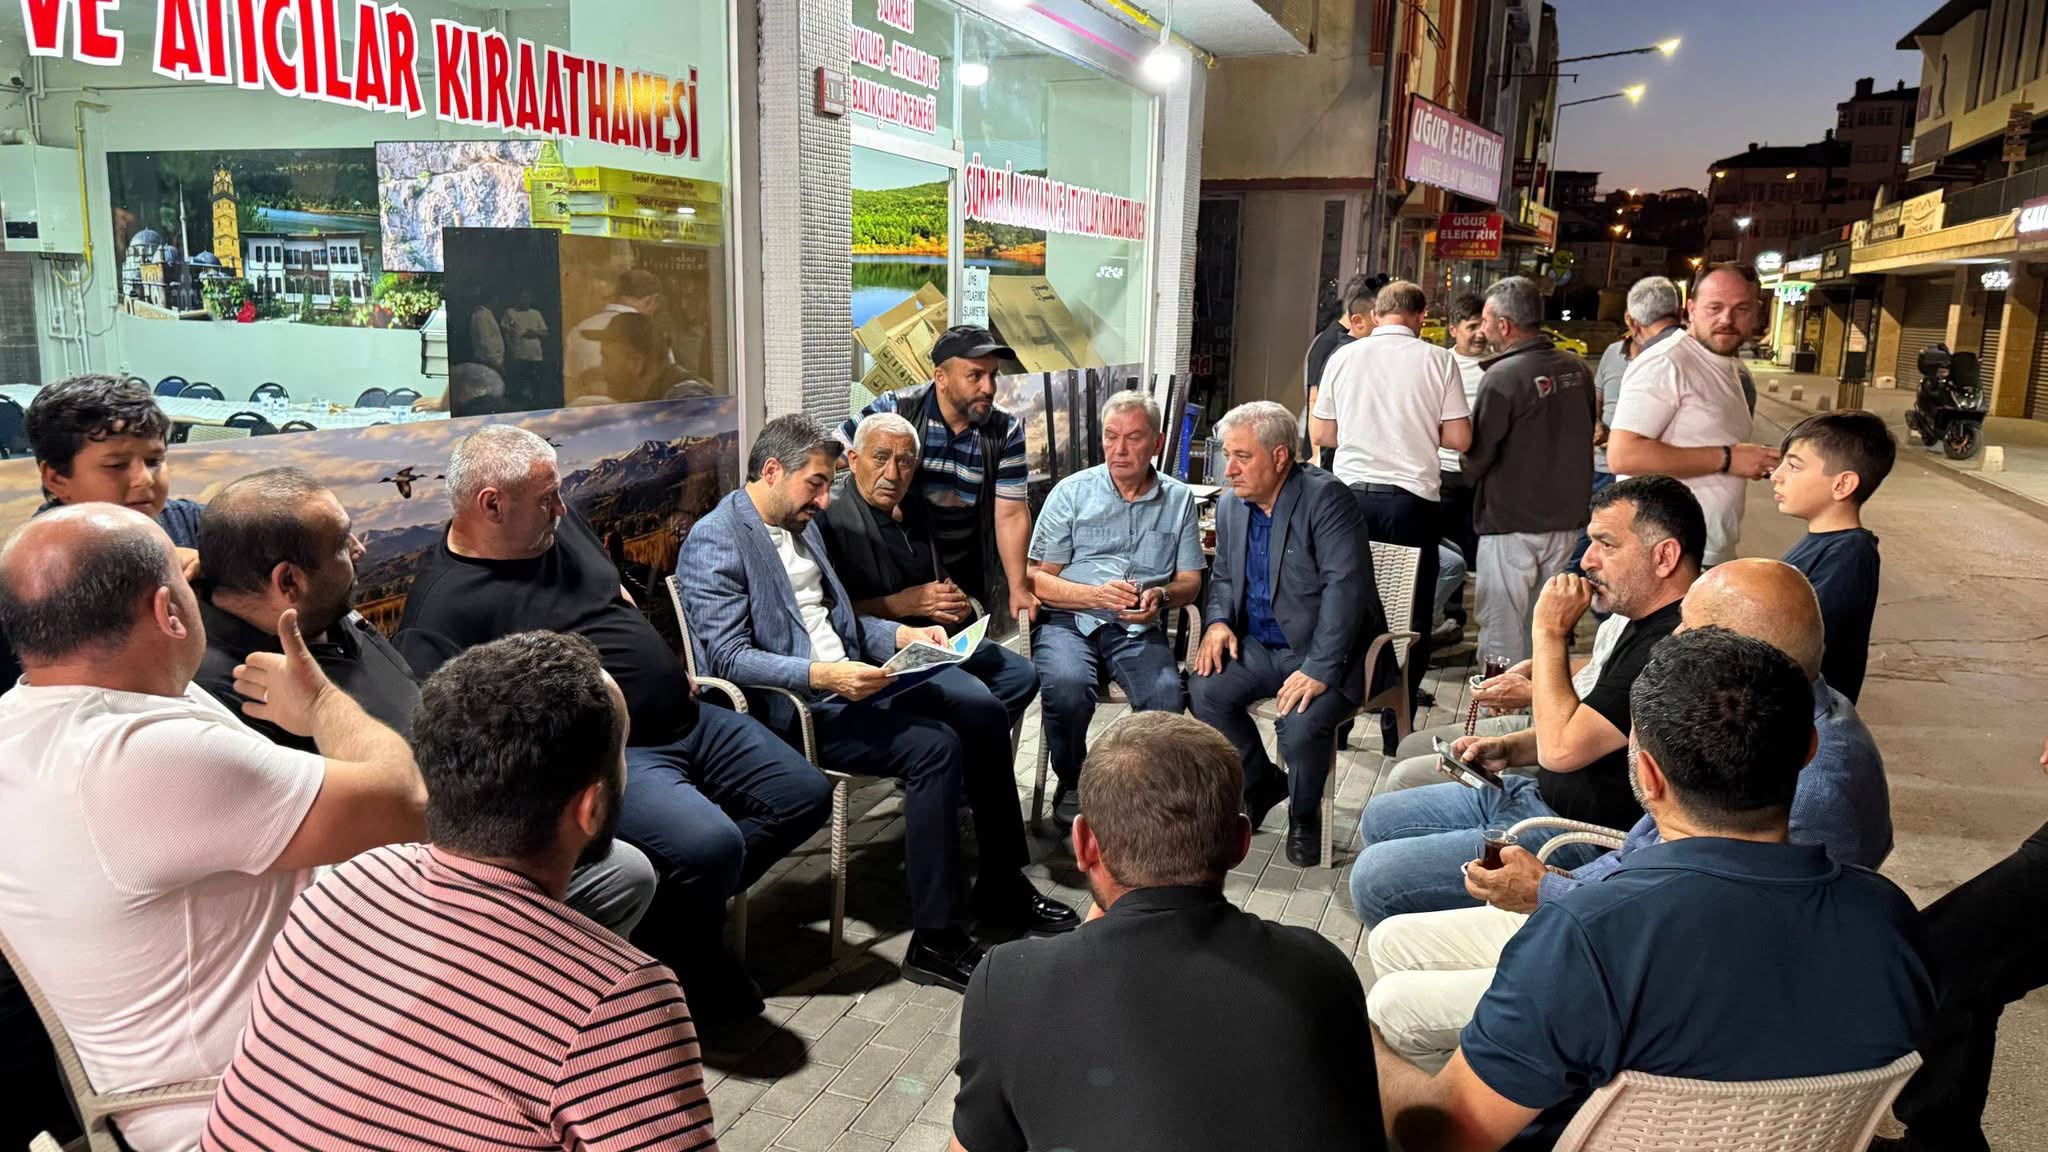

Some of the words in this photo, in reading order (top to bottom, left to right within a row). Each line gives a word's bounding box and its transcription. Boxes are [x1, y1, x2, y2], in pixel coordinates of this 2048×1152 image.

[25, 0, 122, 64] VE
[433, 21, 702, 160] KIRAATHANESİ
[928, 52, 939, 89] VE
[851, 77, 901, 127] BALIKÇILAR
[902, 93, 936, 134] DERNEĞİ
[1413, 104, 1449, 155] UĞUR
[1450, 124, 1502, 171] ELEKTRİK
[965, 153, 1011, 224] SÜRMELİ
[1440, 228, 1497, 240] ELEKTRİK
